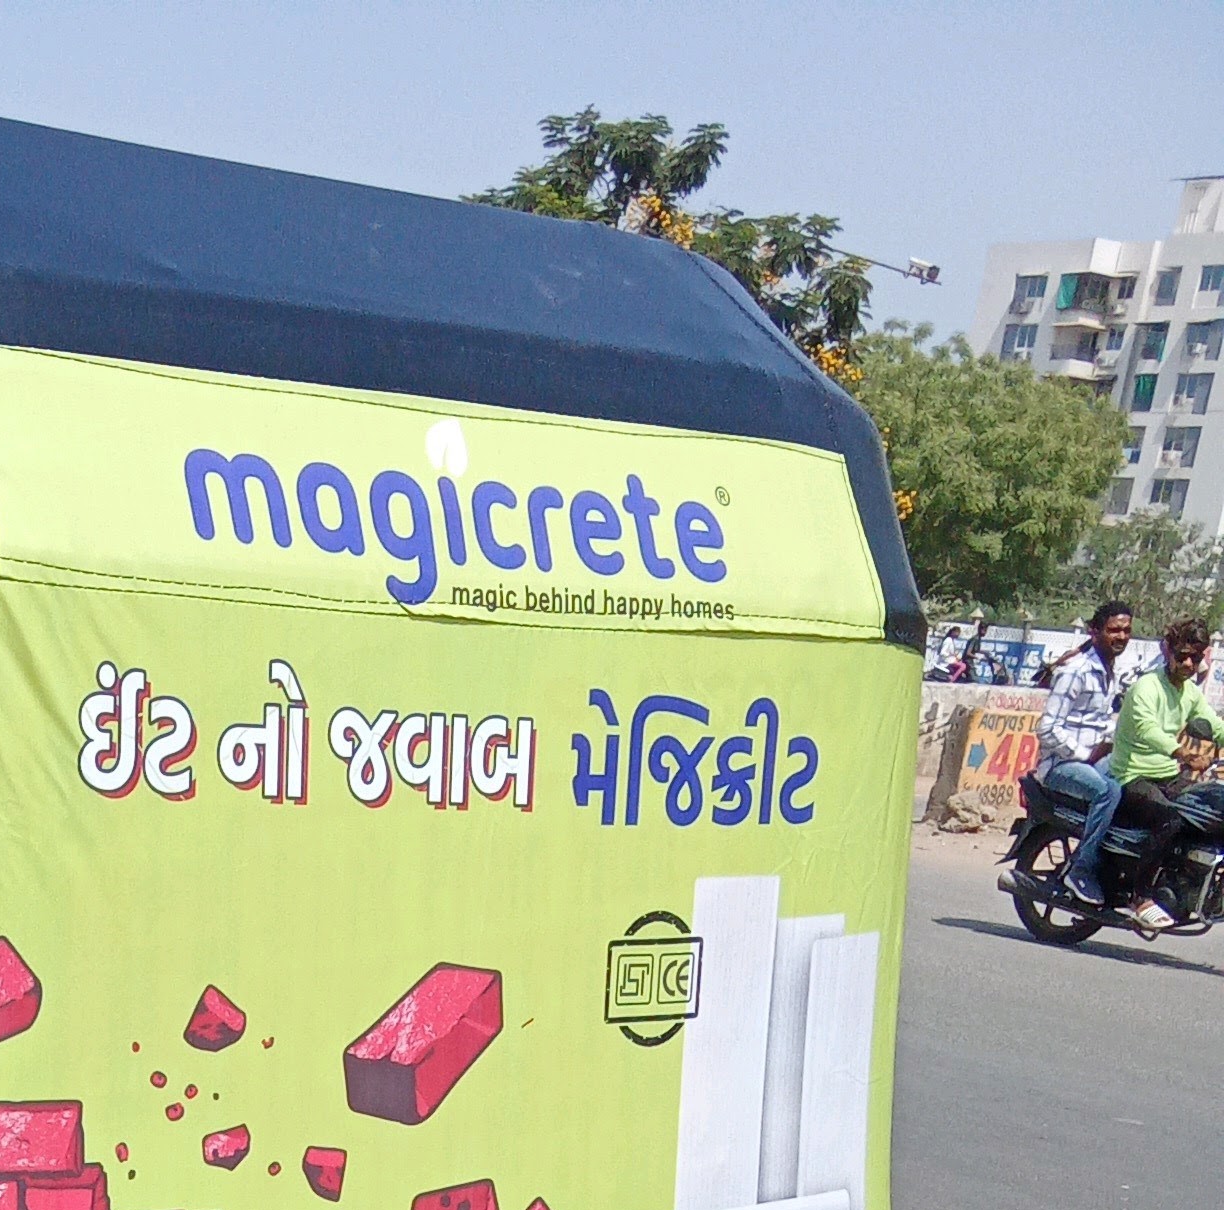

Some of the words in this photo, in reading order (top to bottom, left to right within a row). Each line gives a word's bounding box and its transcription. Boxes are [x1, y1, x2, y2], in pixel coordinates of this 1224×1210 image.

[184, 420, 727, 605] magicrete
[451, 583, 519, 612] magic
[525, 585, 595, 615] behind
[602, 589, 663, 620] happy
[671, 592, 735, 621] homes
[216, 658, 309, 806] નો
[328, 706, 538, 813] જવાબ
[571, 688, 819, 826] મેજિક્રીટ
